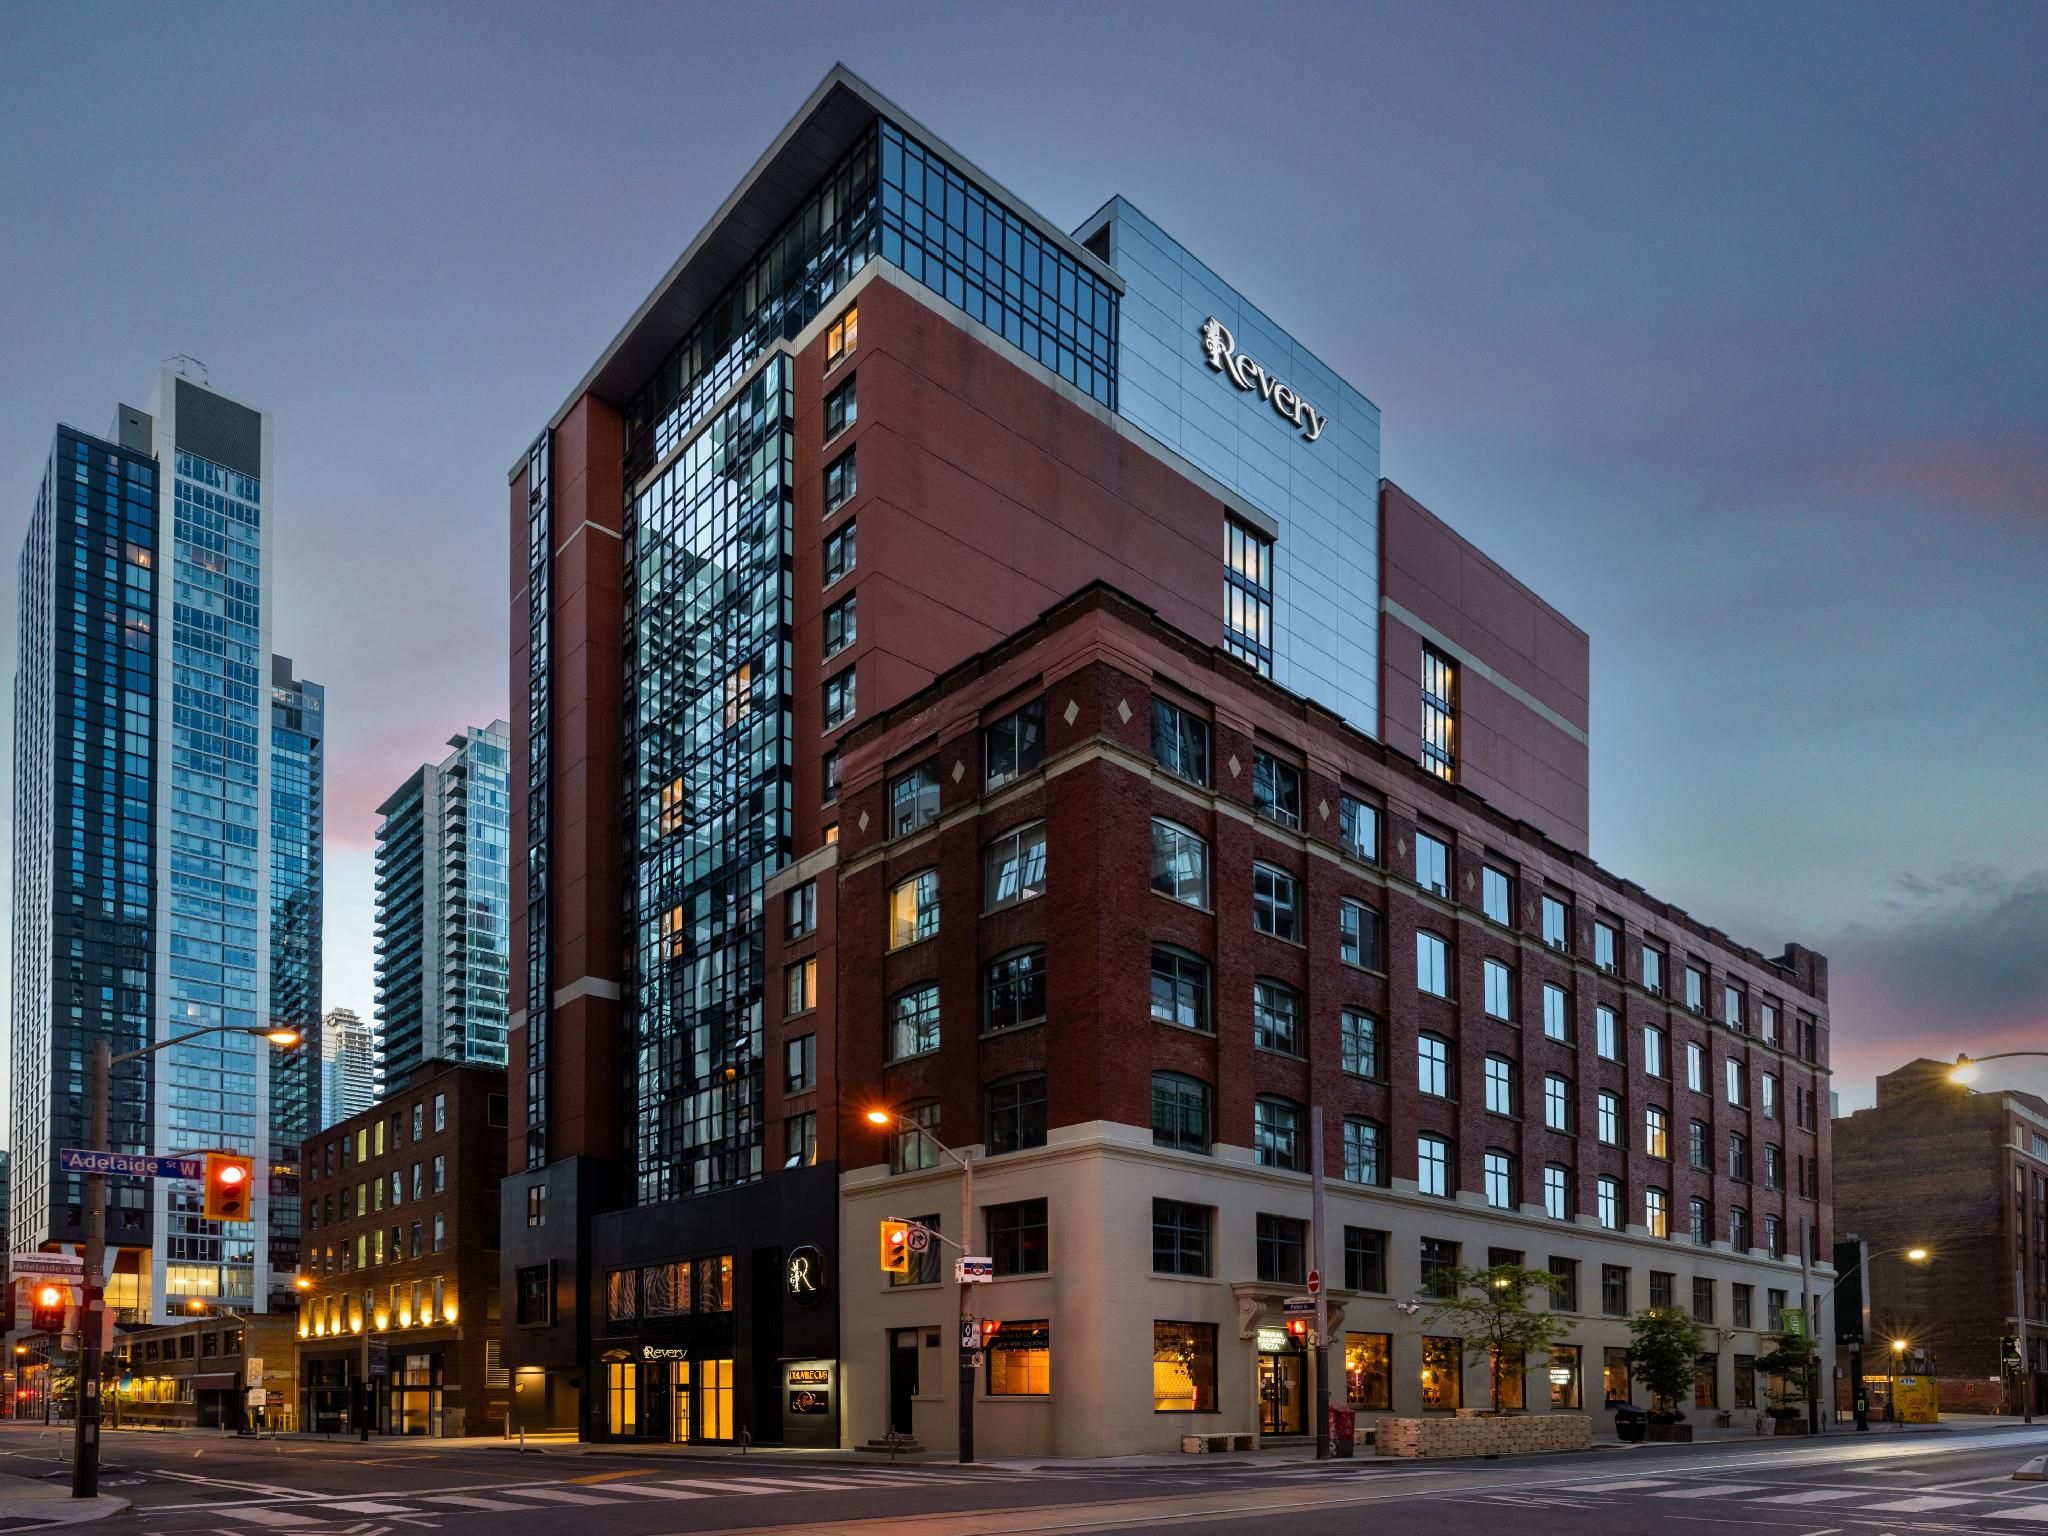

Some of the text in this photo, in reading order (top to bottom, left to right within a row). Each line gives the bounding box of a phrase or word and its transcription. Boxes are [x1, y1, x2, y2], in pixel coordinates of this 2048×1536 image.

[1202, 315, 1328, 441] Revery
[69, 1152, 196, 1177] Adelaide St W
[15, 1262, 61, 1273] Adelaide
[789, 1257, 817, 1292] R
[642, 1345, 688, 1360] Revery
